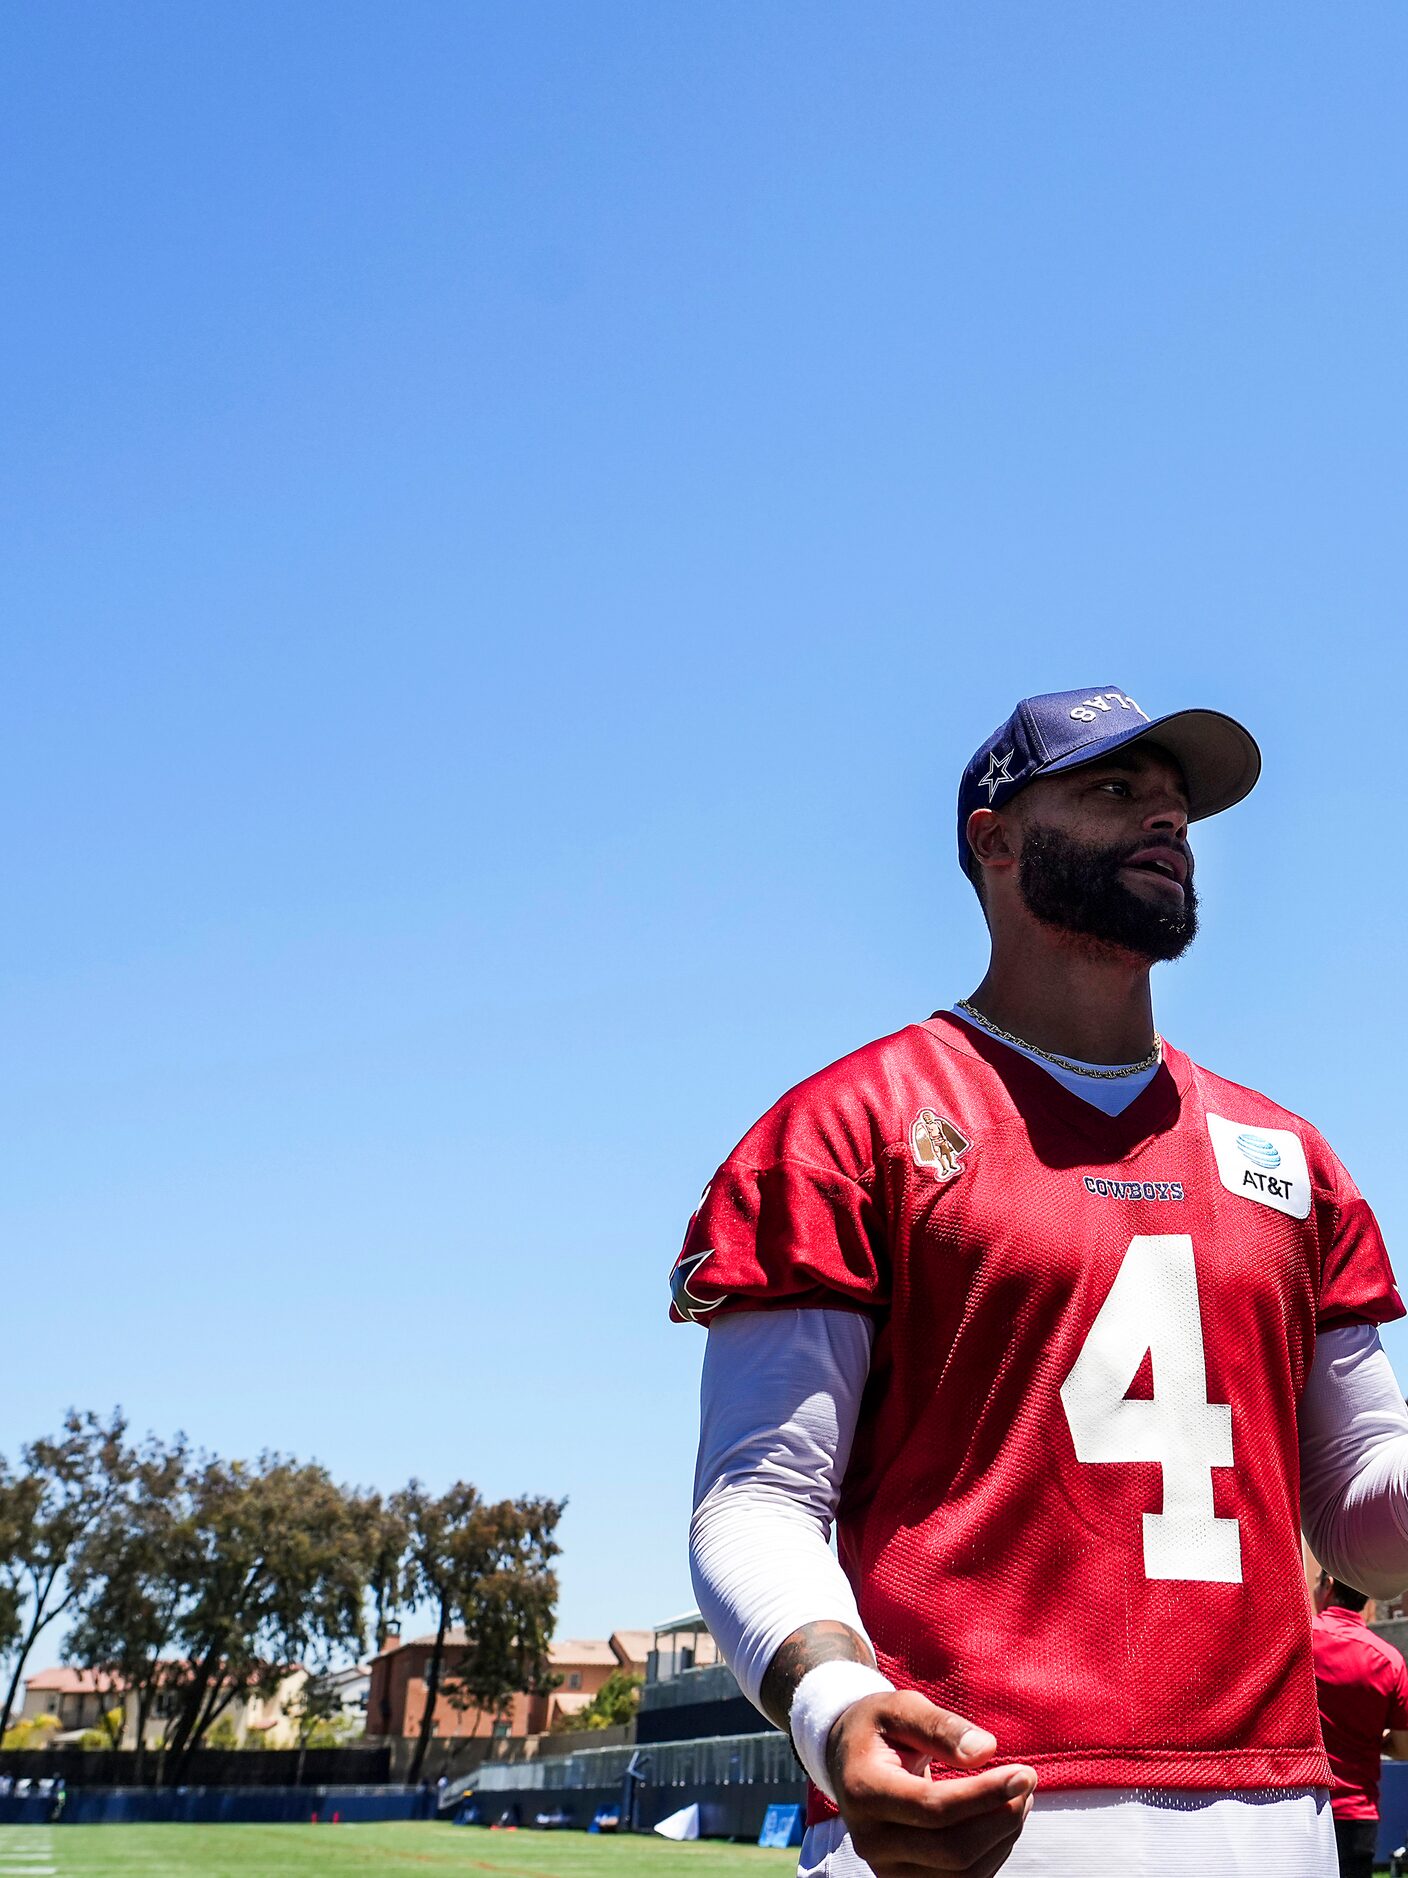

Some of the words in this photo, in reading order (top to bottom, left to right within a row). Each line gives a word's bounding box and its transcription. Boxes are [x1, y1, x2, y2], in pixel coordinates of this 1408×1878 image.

[1083, 1175, 1184, 1202] COWBOYS
[1242, 1170, 1293, 1200] AT&T
[1059, 1233, 1243, 1583] 4
